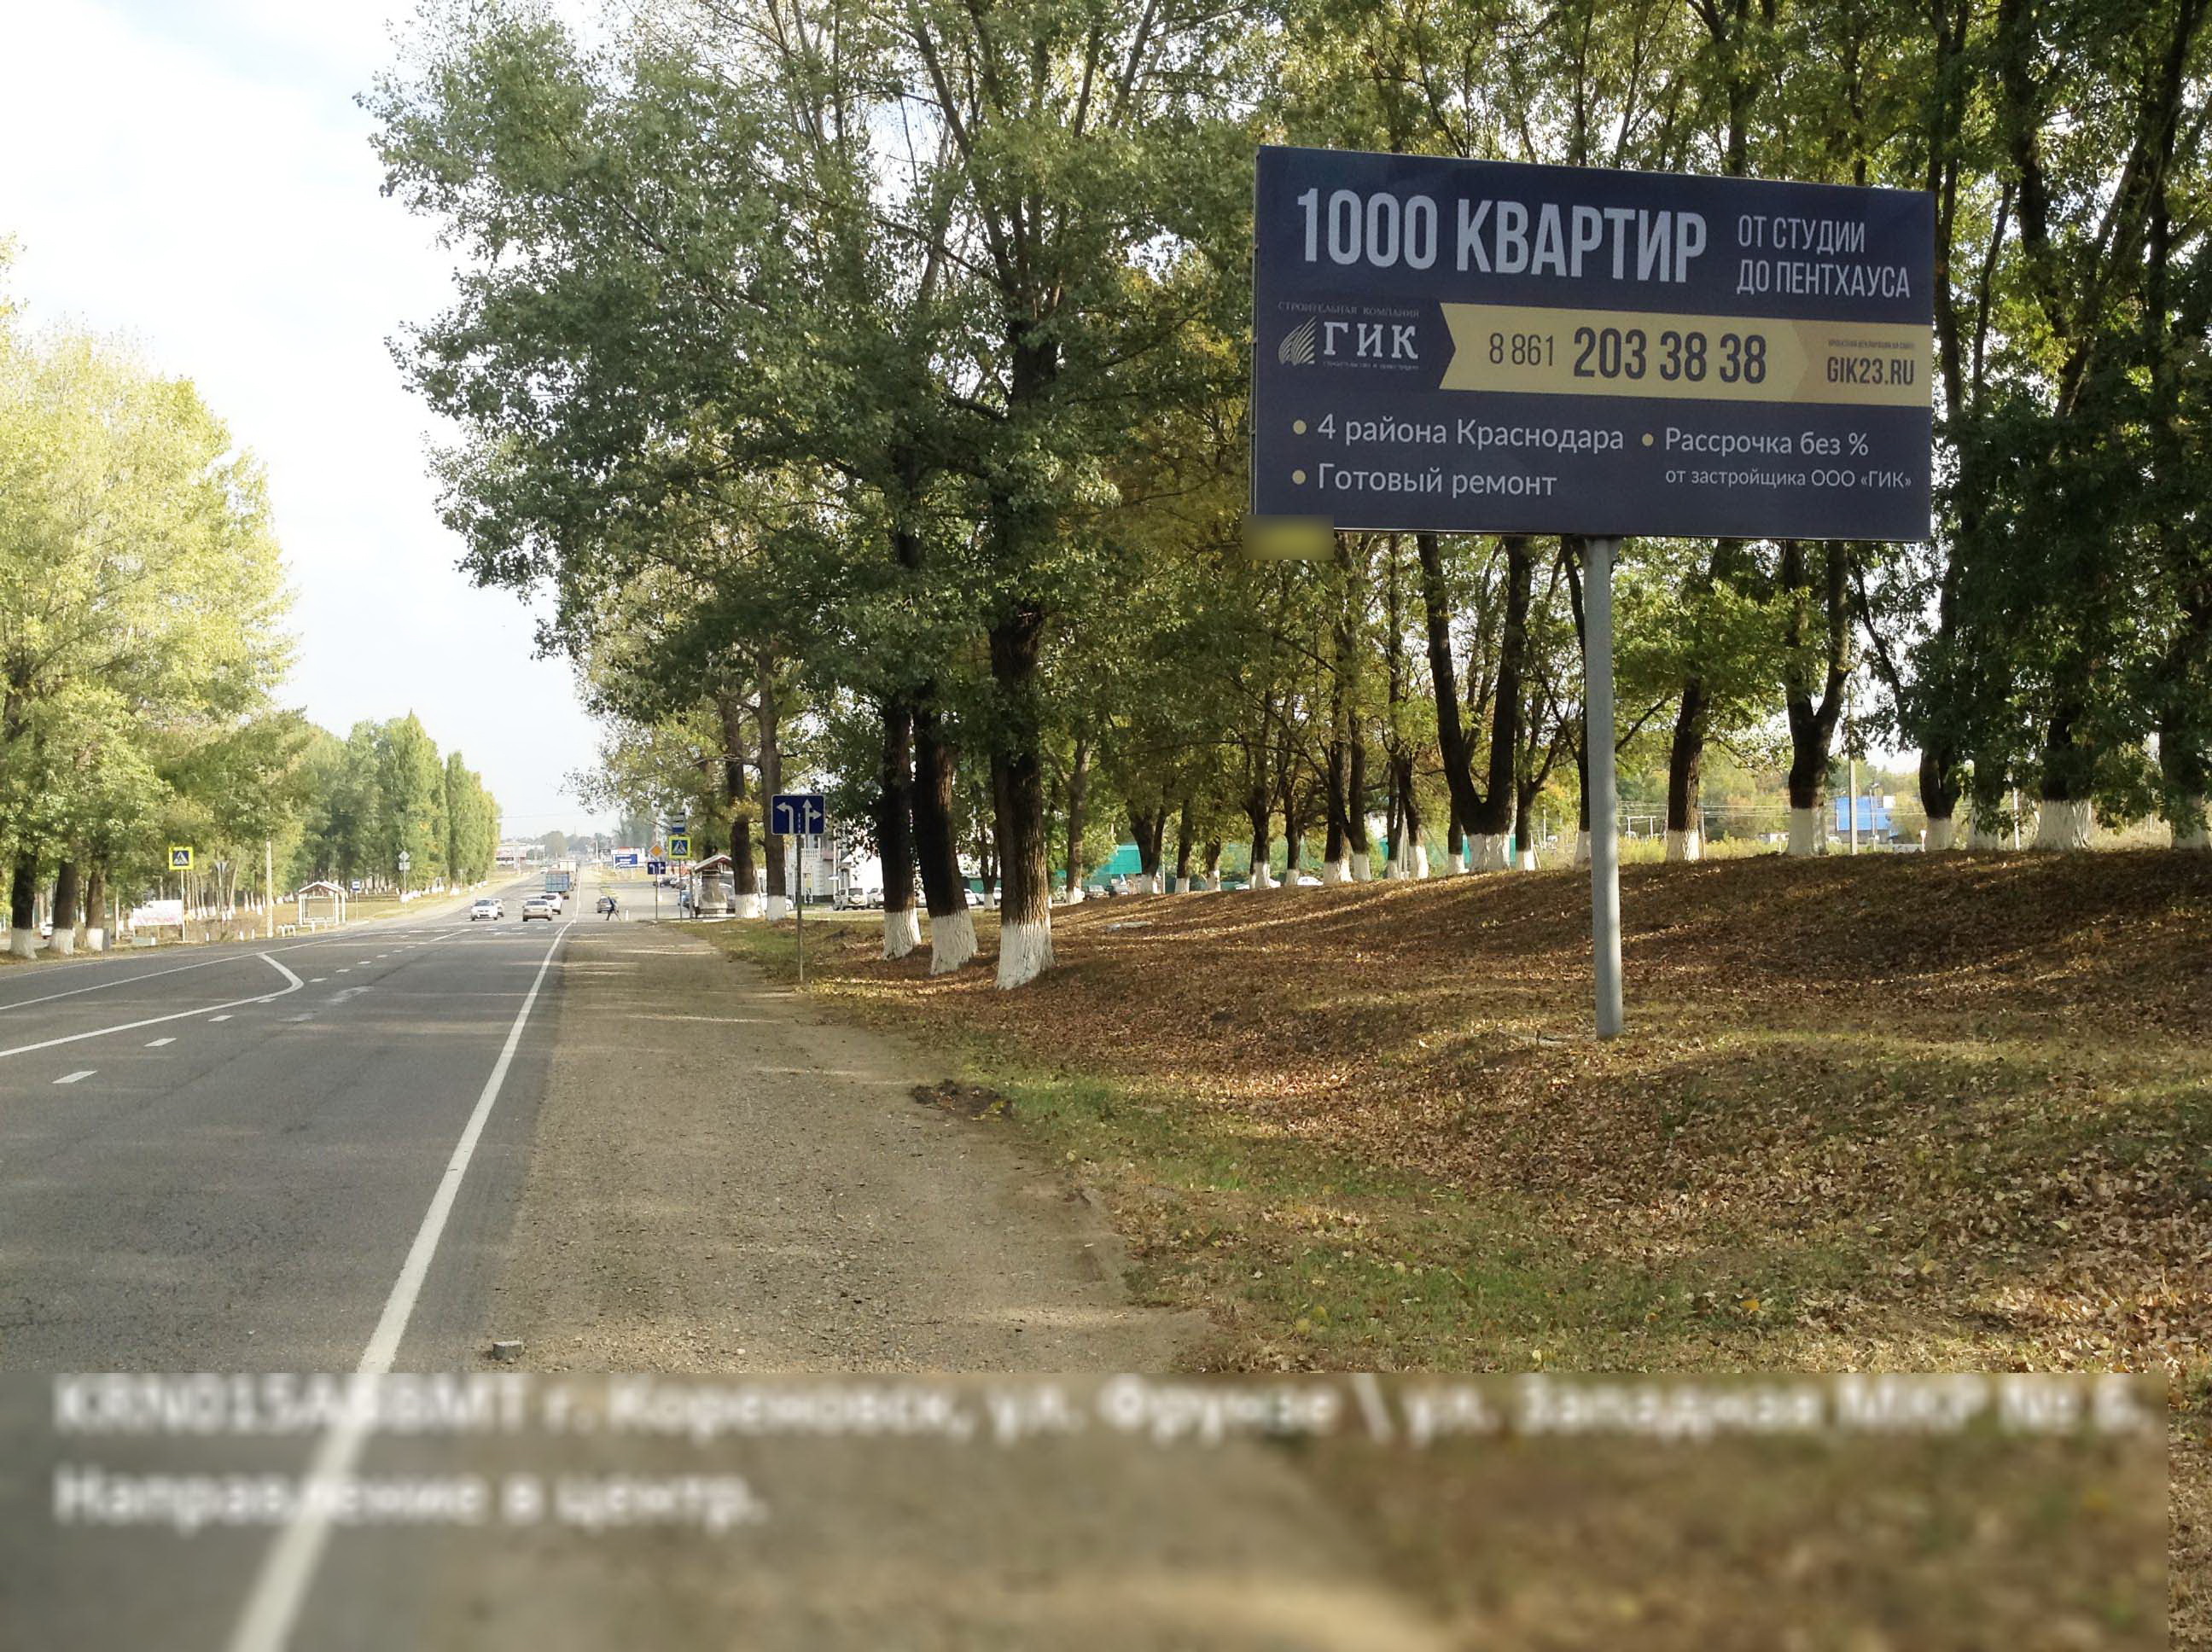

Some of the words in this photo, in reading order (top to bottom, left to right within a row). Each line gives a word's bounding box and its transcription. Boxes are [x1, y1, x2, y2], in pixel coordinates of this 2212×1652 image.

[1297, 188, 1437, 270] 1000
[1457, 199, 1707, 282] КВАРТИР
[1738, 214, 1767, 247] ОТ
[1773, 217, 1865, 255] СТУДИИ
[1737, 259, 1769, 295] ДО
[1777, 261, 1910, 298] ПЕНТХАУСА
[1277, 300, 1358, 315] СТРОИТЕЛЬНАЯ
[1323, 321, 1418, 360] ГИК
[1489, 332, 1504, 364] 8
[1511, 334, 1554, 367] 861
[1573, 326, 1647, 381] 203
[1660, 330, 1707, 381] 38
[1719, 333, 1767, 384] 38
[1826, 356, 1915, 387] GIK23.RU
[1317, 413, 1336, 439] 4
[1345, 416, 1447, 445] района
[1457, 418, 1624, 454] Краснодара
[1665, 427, 1792, 457] Рассрочка
[1800, 431, 1841, 455] без
[1848, 433, 1869, 456] %
[1318, 463, 1442, 492] Готовый
[1452, 474, 1557, 498] ремонт
[1665, 469, 1685, 484] от
[1691, 468, 1806, 489] застройщика
[1811, 469, 1855, 487] ООО
[1860, 470, 1912, 489] «ГИК»
